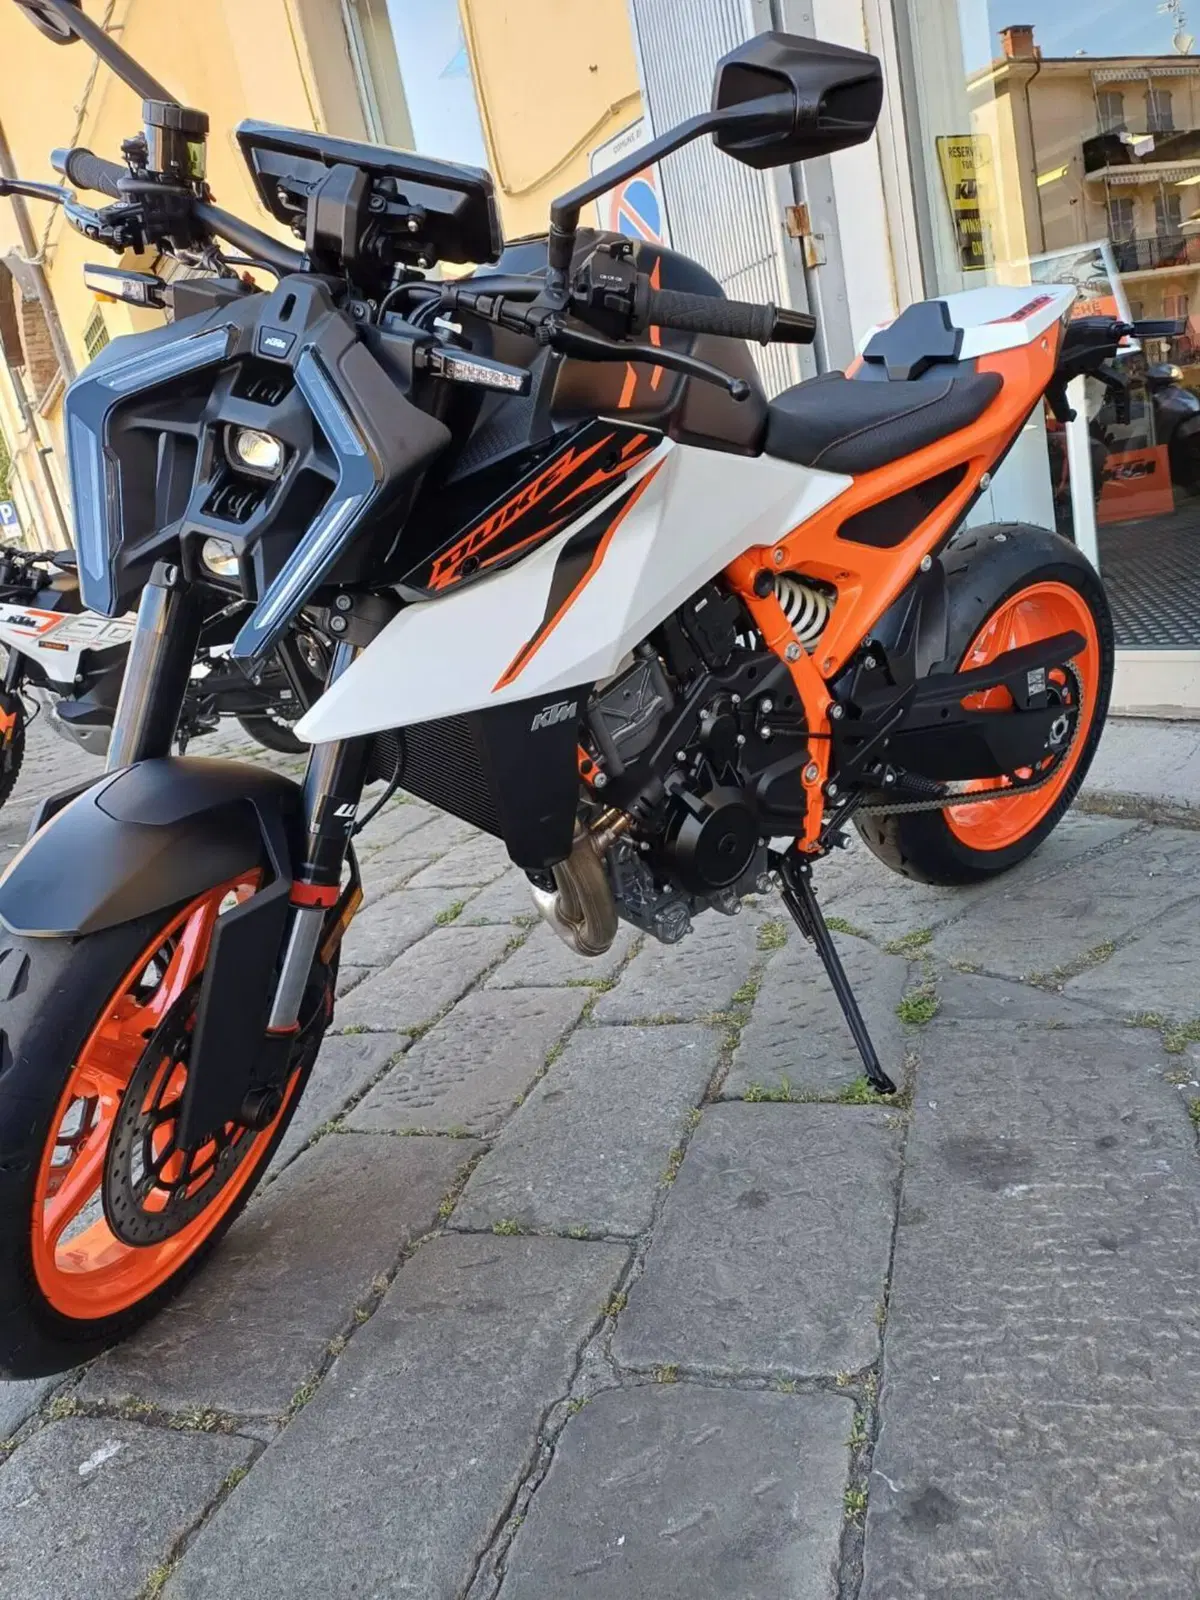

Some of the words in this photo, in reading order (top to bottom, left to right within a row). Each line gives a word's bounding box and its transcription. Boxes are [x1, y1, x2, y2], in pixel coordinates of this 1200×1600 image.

[947, 145, 983, 159] RESERV
[264, 337, 287, 349] KTM
[428, 440, 600, 591] DUKE
[7, 614, 37, 628] KTM
[530, 700, 578, 732] KTM
